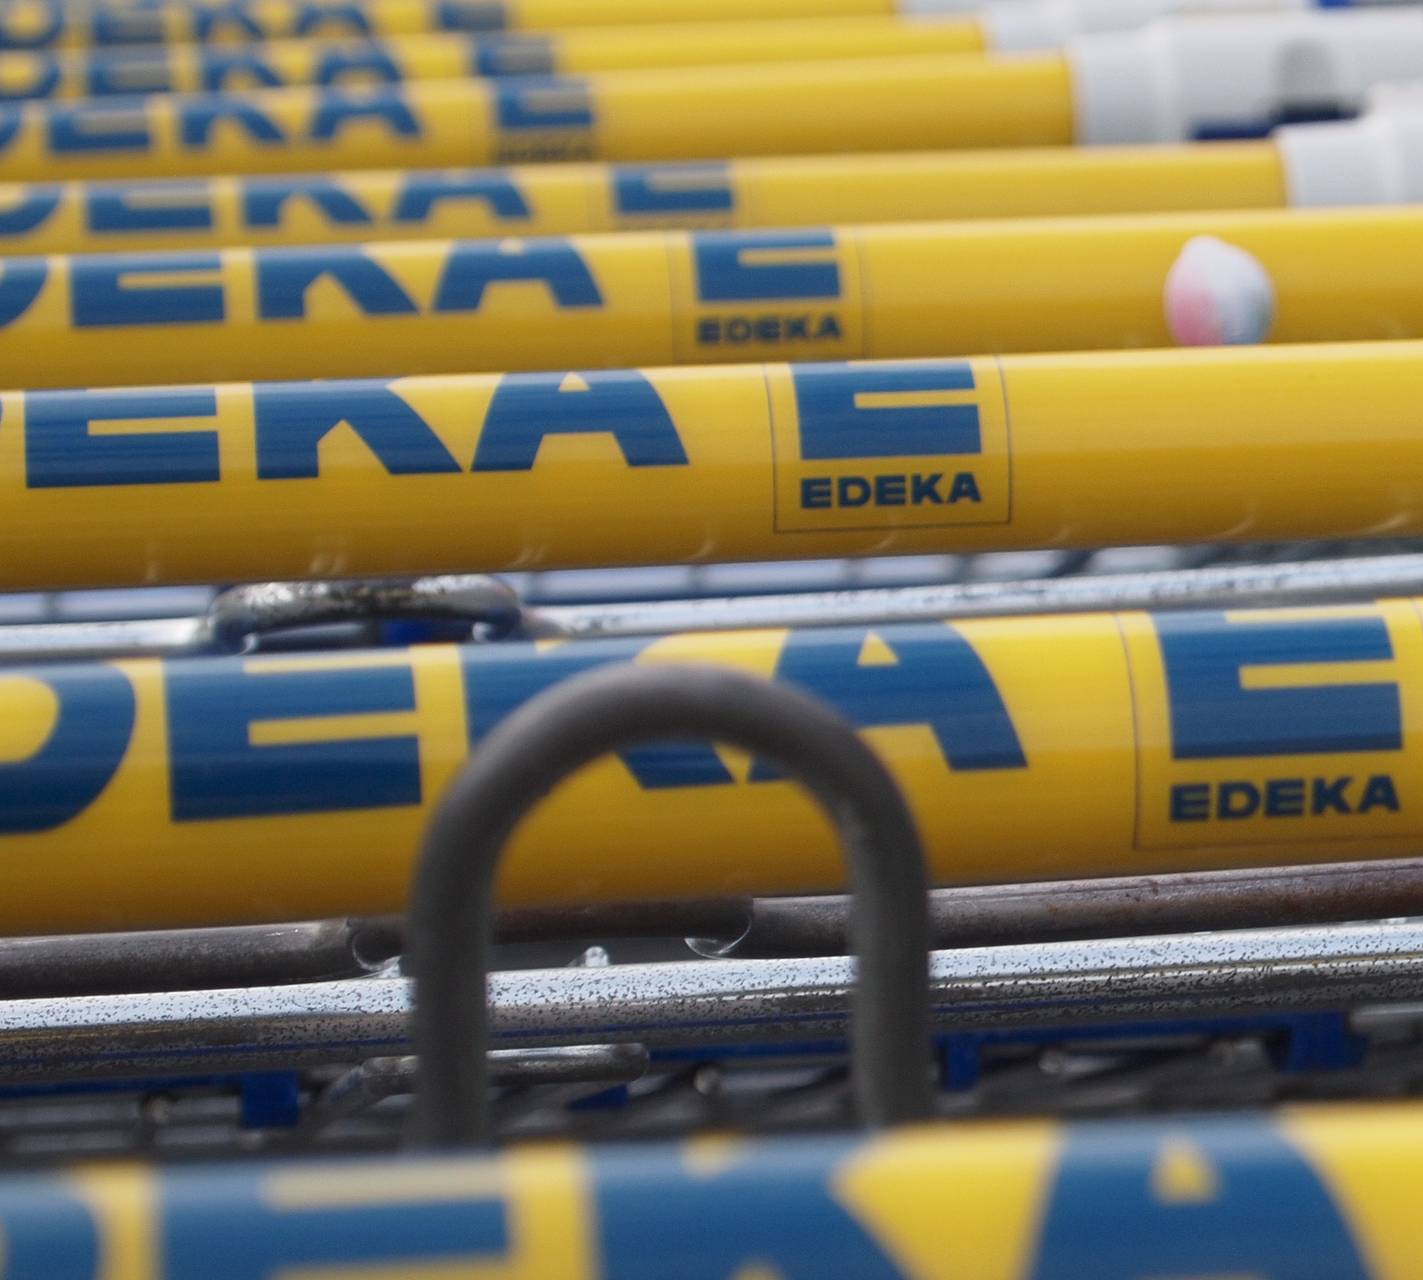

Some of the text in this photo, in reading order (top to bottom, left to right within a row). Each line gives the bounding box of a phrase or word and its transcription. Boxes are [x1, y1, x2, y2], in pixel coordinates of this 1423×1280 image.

[697, 314, 842, 345] EDEKA
[0, 370, 689, 489] EKA
[801, 472, 982, 509] EDEKA
[1150, 602, 1402, 760] E
[1170, 775, 1400, 822] EDEKA
